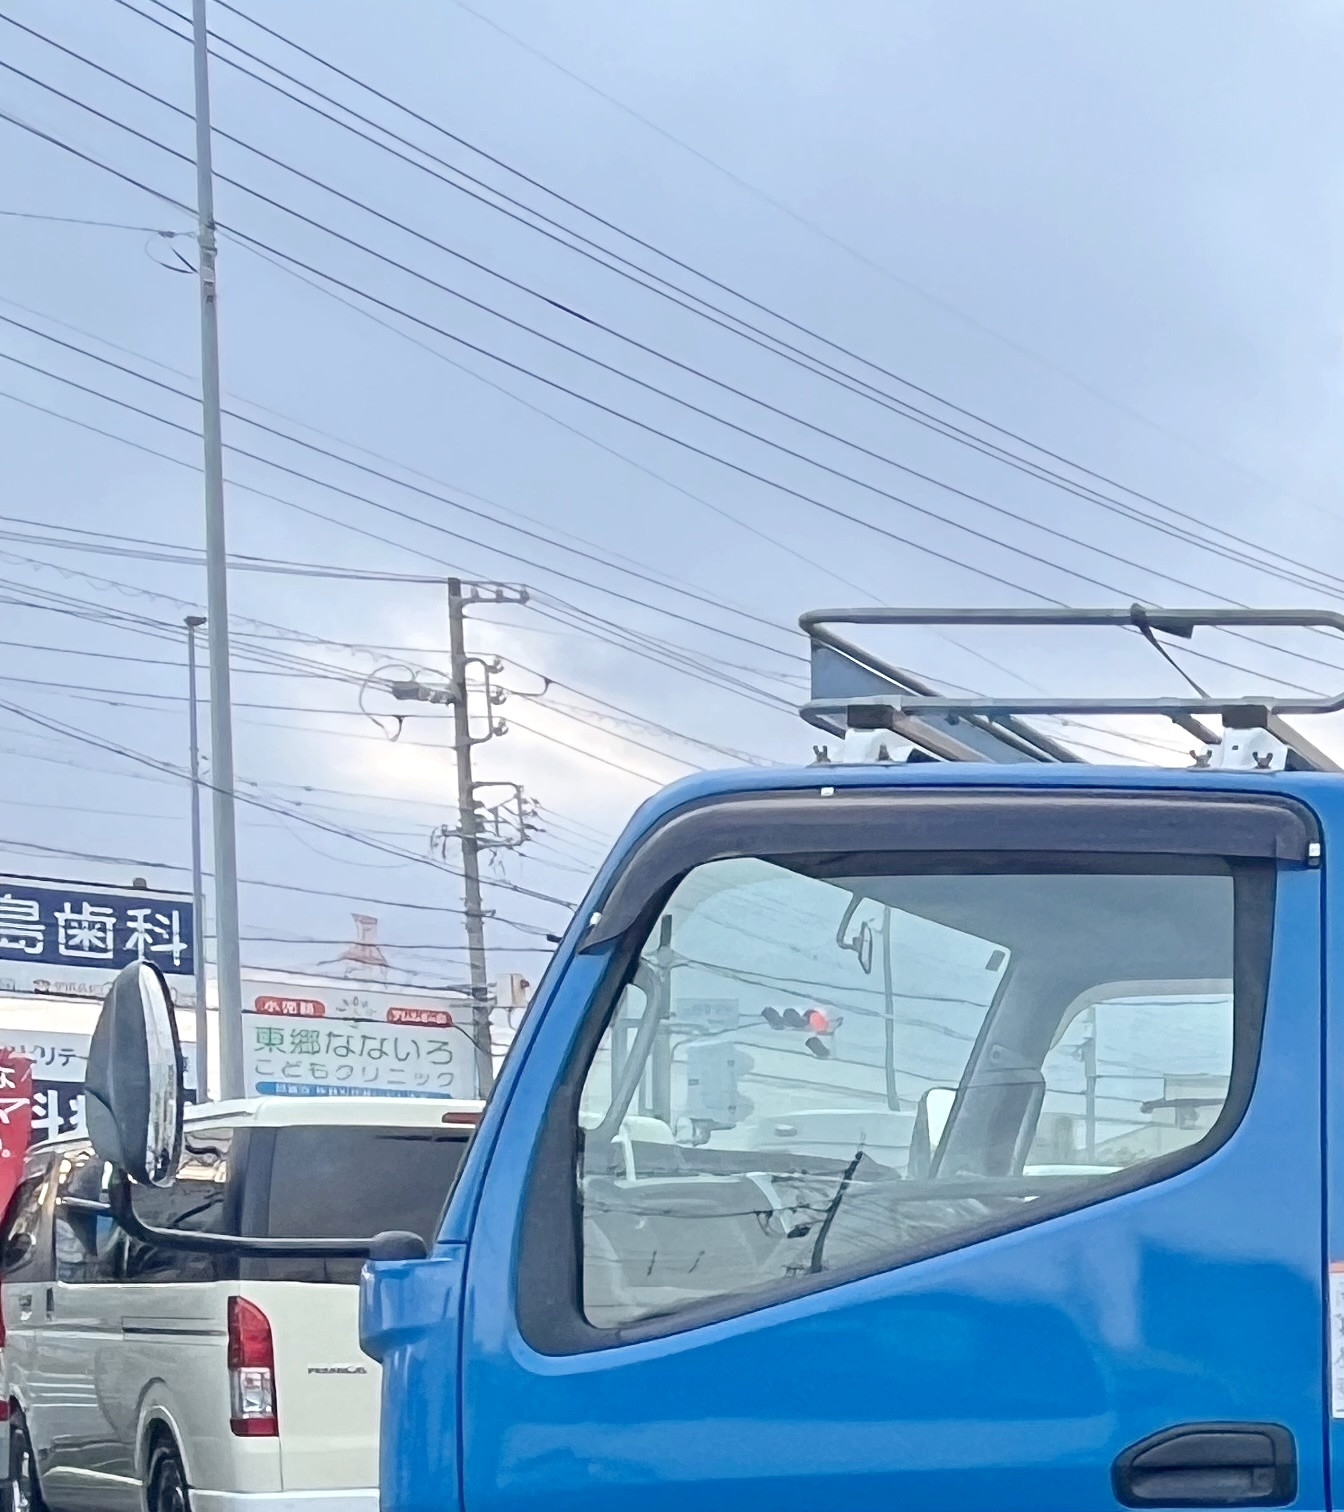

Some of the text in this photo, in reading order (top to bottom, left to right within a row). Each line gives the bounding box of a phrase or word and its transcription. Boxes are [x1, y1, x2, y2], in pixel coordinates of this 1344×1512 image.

[0, 893, 188, 967] 島歯科
[254, 1026, 453, 1065] 東郷なないろ
[255, 1059, 454, 1087] こどもクリニック
